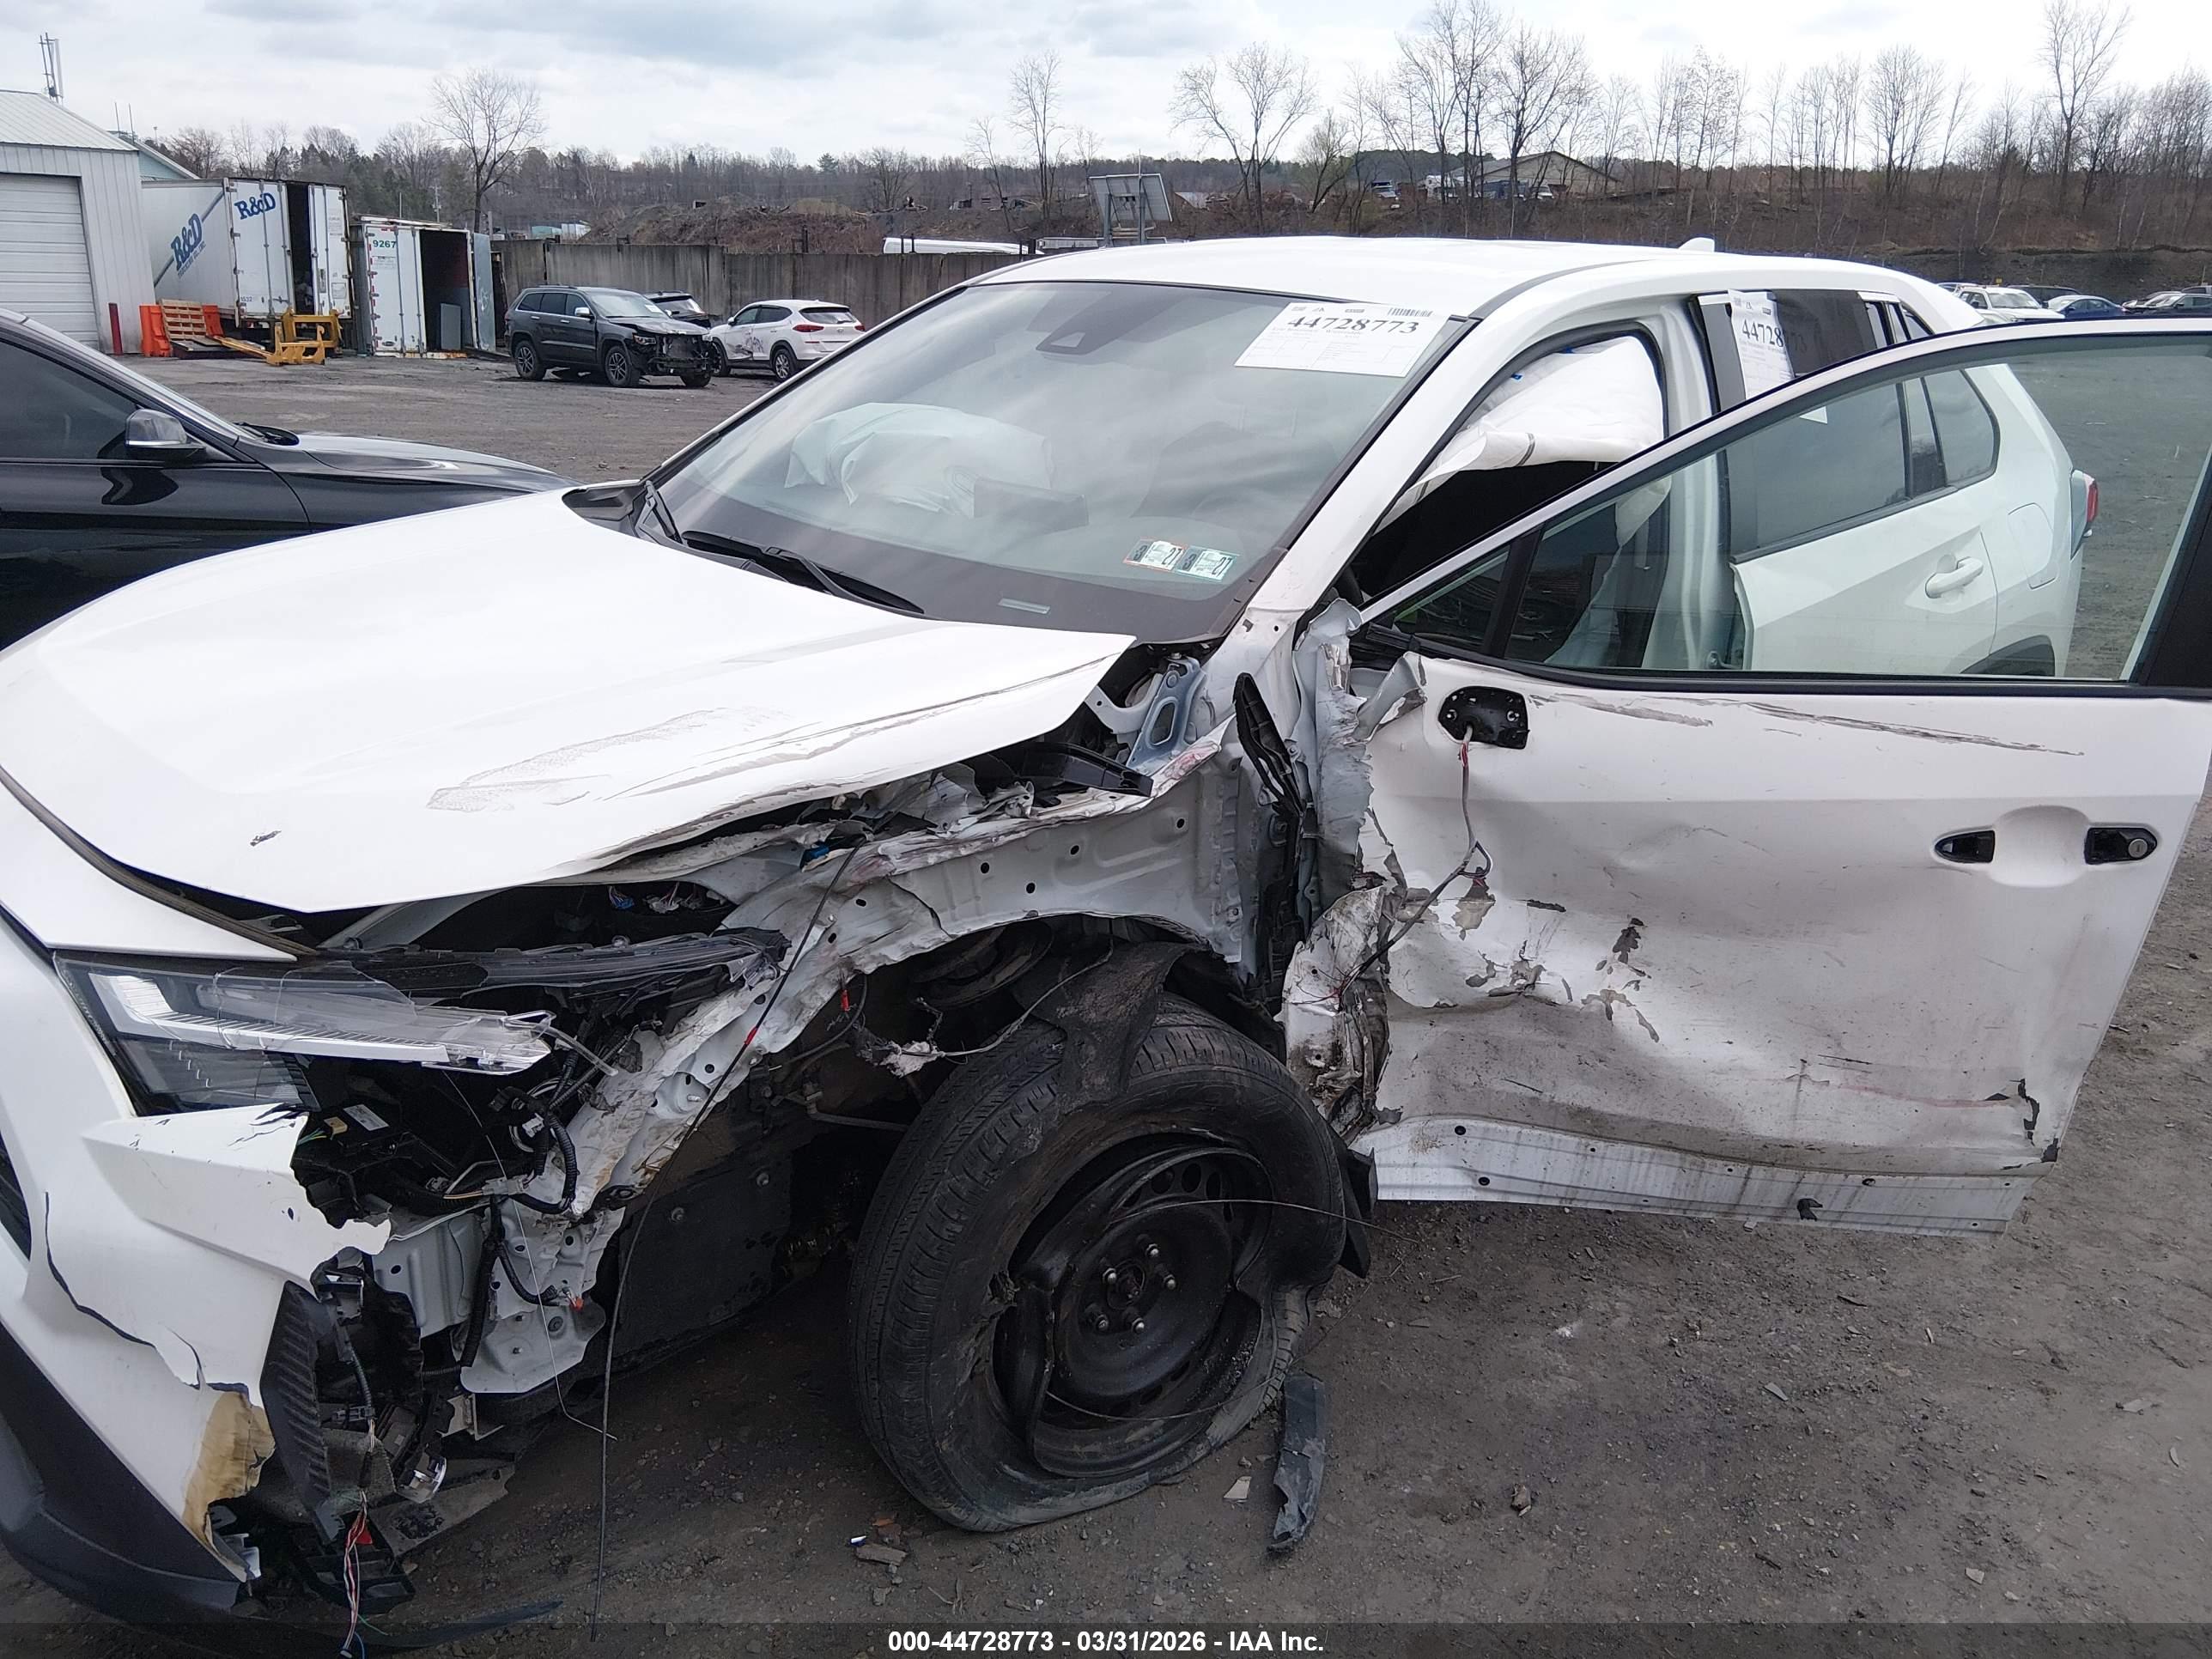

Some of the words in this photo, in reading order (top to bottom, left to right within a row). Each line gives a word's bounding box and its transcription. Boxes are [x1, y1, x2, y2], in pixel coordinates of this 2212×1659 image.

[234, 192, 276, 220] R&D
[171, 213, 202, 271] R&D
[373, 240, 397, 248] 9267
[1287, 316, 1419, 334] 44728773
[1161, 547, 1182, 566] 27
[1211, 556, 1233, 576] 27
